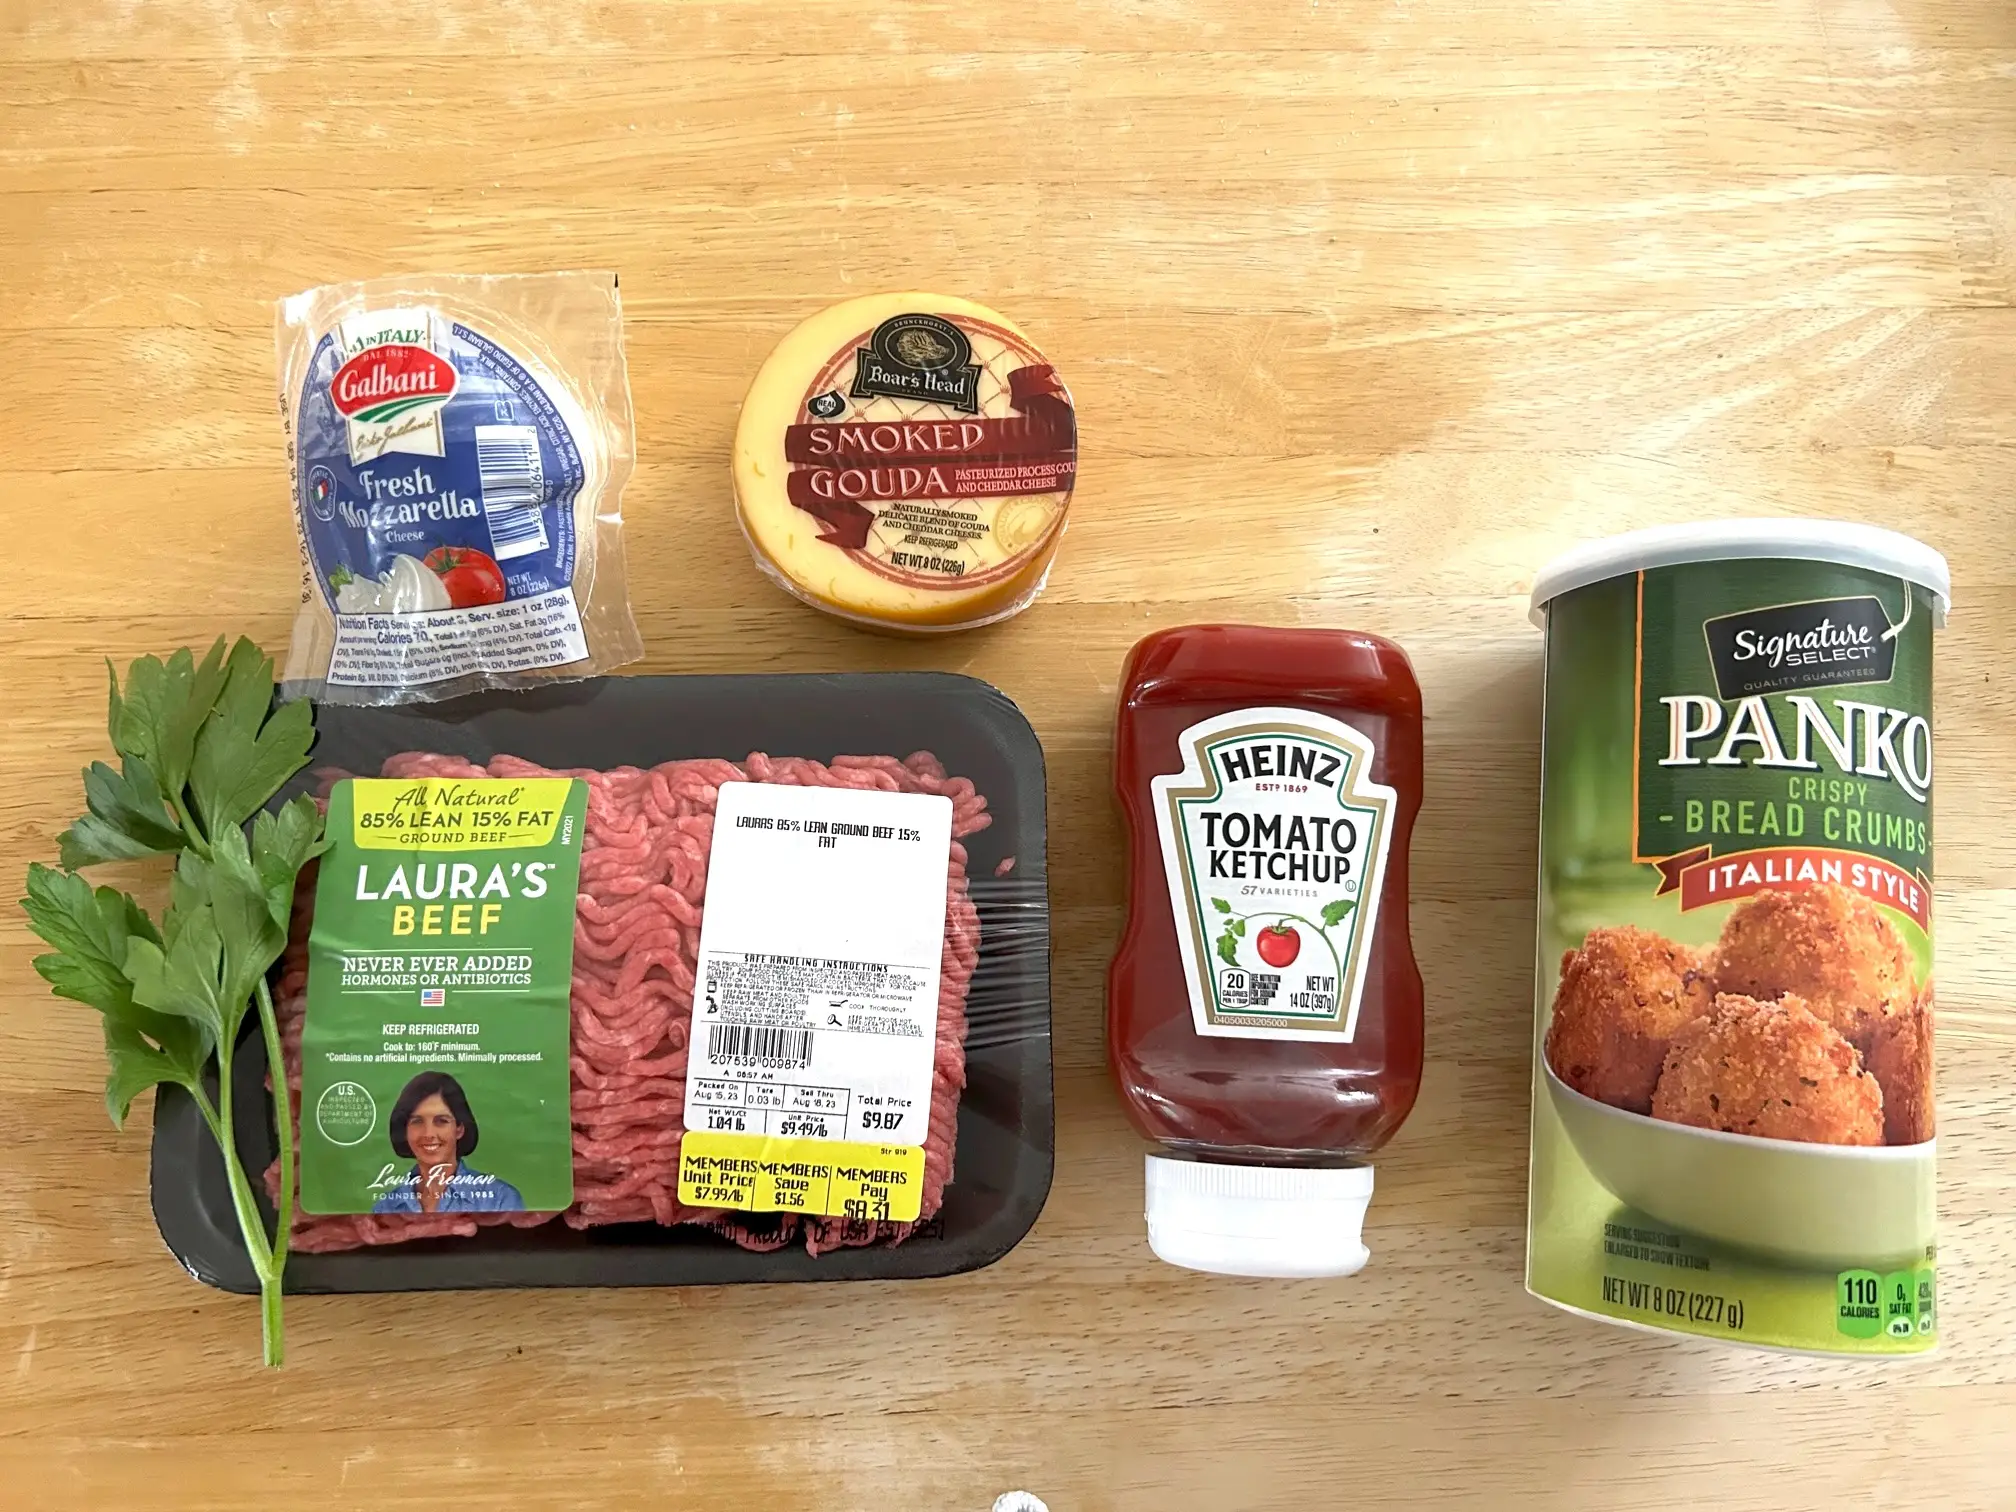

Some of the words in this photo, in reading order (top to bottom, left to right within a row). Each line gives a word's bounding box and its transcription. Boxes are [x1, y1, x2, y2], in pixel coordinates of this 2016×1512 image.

[340, 363, 440, 402] Galbani
[868, 365, 919, 388] Boar's
[925, 372, 965, 394] Head
[819, 398, 836, 408] REAL
[809, 423, 984, 454] SMOKED
[955, 467, 1015, 480] PASTEURIZED
[1017, 464, 1056, 477] PROCESS
[359, 464, 436, 500] Fresh
[810, 467, 948, 499] GOUDA
[956, 480, 975, 493] AND
[977, 479, 1022, 492] CHEDDAR
[1023, 477, 1056, 490] CHEESE
[338, 490, 481, 528] Mozzarella
[893, 503, 942, 517] NATURALLY
[942, 510, 978, 521] SMOKED
[879, 510, 919, 524] DELICATE
[920, 515, 948, 527] BLEND
[949, 518, 960, 528] OF
[960, 520, 990, 532] GOUDA
[883, 520, 903, 531] AND
[904, 522, 943, 536] CHEDDAR
[386, 530, 425, 543] Cheese
[891, 552, 907, 565] NET
[909, 554, 922, 567] WT
[924, 556, 930, 568] 8
[930, 557, 941, 570] OZ
[942, 559, 964, 576] (226g)
[508, 572, 522, 585] NET
[522, 572, 532, 583] WT
[510, 587, 516, 597] 8
[517, 584, 527, 595] OZ
[528, 576, 550, 592] (226g)
[468, 613, 495, 623] Serv.
[496, 608, 520, 617] size:
[1733, 618, 1872, 668] Signature
[1785, 646, 1871, 667] SELECT
[1744, 675, 1798, 692] QUALITY
[1803, 667, 1876, 682] GUARANTEED
[1658, 696, 1932, 802] PANKO
[1220, 744, 1341, 788] HEINZ
[1283, 784, 1308, 793] 1869
[1789, 776, 1868, 806] CRISPY
[393, 786, 427, 813] All
[360, 813, 404, 828] 85%
[409, 811, 462, 828] LEAN
[472, 812, 512, 827] 15%
[517, 811, 554, 826] FAT
[1686, 799, 1804, 837] BREAD
[1824, 806, 1926, 856] CRUMBS
[561, 815, 574, 845] MY2021
[736, 815, 773, 829] LAURAS
[777, 819, 800, 832] 85%
[804, 820, 828, 834] LEAN
[831, 823, 869, 837] GROUND
[873, 826, 895, 839] BEEF
[898, 828, 921, 842] 15%
[1200, 812, 1357, 854] TOMATO
[400, 833, 464, 844] GROUND
[469, 832, 508, 843] BEEF
[818, 836, 837, 848] FAT
[1209, 849, 1351, 884] KETCHUP
[356, 862, 548, 900] LAURA'S
[1707, 857, 1843, 893] ITALIAN
[1851, 864, 1920, 914] STYLE
[1241, 885, 1257, 896] 57
[1260, 887, 1319, 898] VARIETIES
[392, 904, 502, 936] BEEF
[342, 956, 404, 972] NEVER
[410, 956, 458, 971] EVER
[464, 955, 532, 971] ADDED
[744, 954, 766, 964] SAFE
[769, 955, 818, 968] HANDLING
[822, 959, 889, 973] INSTRUCTIONS
[341, 974, 417, 986] HORMONES
[419, 974, 439, 985] OR
[443, 973, 532, 985] ANTIBIOTICS
[1227, 974, 1244, 988] 20
[1306, 975, 1322, 990] NET
[1323, 976, 1335, 992] WT
[1222, 990, 1248, 998] CALORIES
[1290, 992, 1298, 1007] 14
[1300, 993, 1310, 1008] OZ
[1311, 994, 1335, 1012] (397g)
[382, 1024, 407, 1035] KEEP
[409, 1023, 480, 1035] REFRIGERATED
[383, 1042, 403, 1051] Cook
[405, 1042, 415, 1051] to:
[441, 1042, 480, 1051] minimum.
[375, 1052, 407, 1062] artificial
[409, 1053, 456, 1064] ingredients.
[458, 1052, 497, 1063] Minimally
[499, 1052, 543, 1063] processed.
[698, 1081, 725, 1090] Packed
[728, 1083, 739, 1091] On
[756, 1086, 774, 1094] Tare
[818, 1090, 834, 1098] Thru
[694, 1090, 712, 1100] Aug
[728, 1092, 738, 1100] 23
[748, 1094, 770, 1105] 0.03
[772, 1096, 781, 1105] lb
[858, 1095, 883, 1106] Total
[888, 1098, 912, 1108] Price
[708, 1108, 721, 1116] Net
[724, 1109, 747, 1117] Wt/Ct
[792, 1099, 810, 1109] Aug
[826, 1100, 836, 1109] 23
[735, 1119, 745, 1131] lb
[806, 1115, 824, 1123] Price
[862, 1111, 904, 1131] $9.87
[781, 1121, 828, 1137] $9.49/lb
[367, 1164, 423, 1189] Laura
[426, 1164, 496, 1188] Freeman
[683, 1170, 712, 1185] Unit
[720, 1172, 754, 1187] Price
[685, 1156, 758, 1173] MEMBERS
[759, 1161, 829, 1178] MEMBERS
[836, 1167, 908, 1185] MEMBERS
[775, 1177, 809, 1191] Save
[861, 1183, 888, 1200] Pay
[470, 1191, 495, 1199] 1985
[695, 1186, 744, 1202] $7.99/lb
[774, 1192, 804, 1207] $1.56
[1844, 1278, 1877, 1304] 110
[1602, 1276, 1625, 1304] NET
[1628, 1281, 1650, 1310] WT
[1654, 1287, 1662, 1313] 8
[1666, 1289, 1685, 1316] OZ
[1689, 1292, 1723, 1324] (227
[1727, 1300, 1744, 1329] g)
[1840, 1306, 1879, 1319] CALORIES
